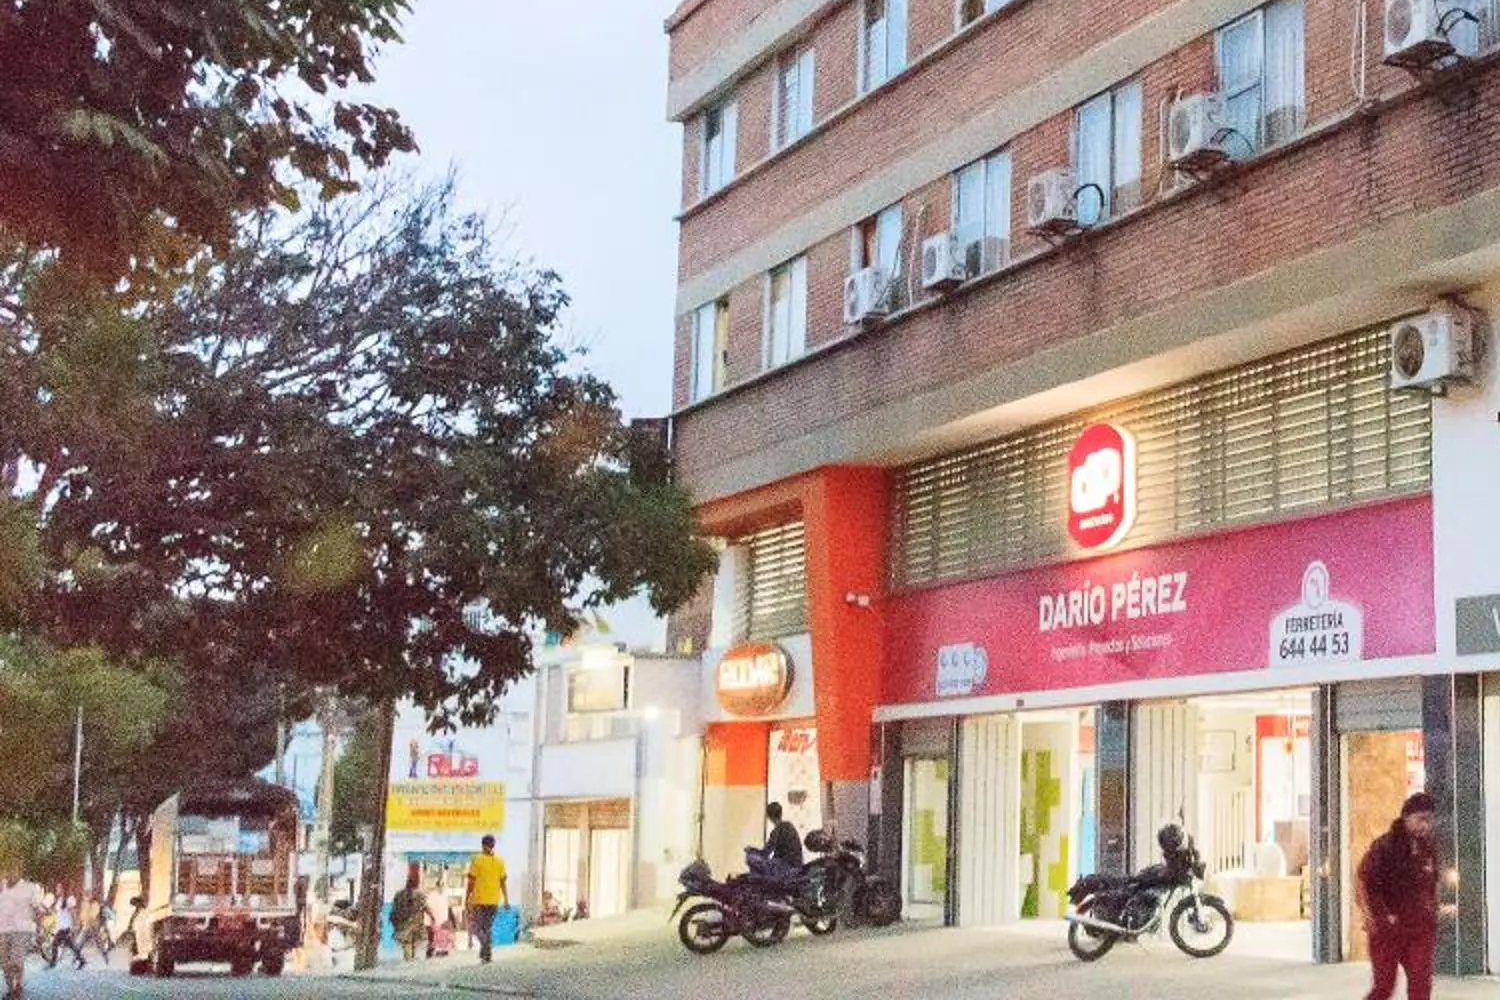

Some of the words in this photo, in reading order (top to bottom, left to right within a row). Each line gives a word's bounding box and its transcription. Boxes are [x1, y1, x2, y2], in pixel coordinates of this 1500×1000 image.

[1039, 579, 1106, 633] DARÍO
[1111, 570, 1188, 622] PÉREZ
[1279, 636, 1305, 660] 644
[1309, 633, 1328, 657] 44
[1331, 631, 1350, 655] 53
